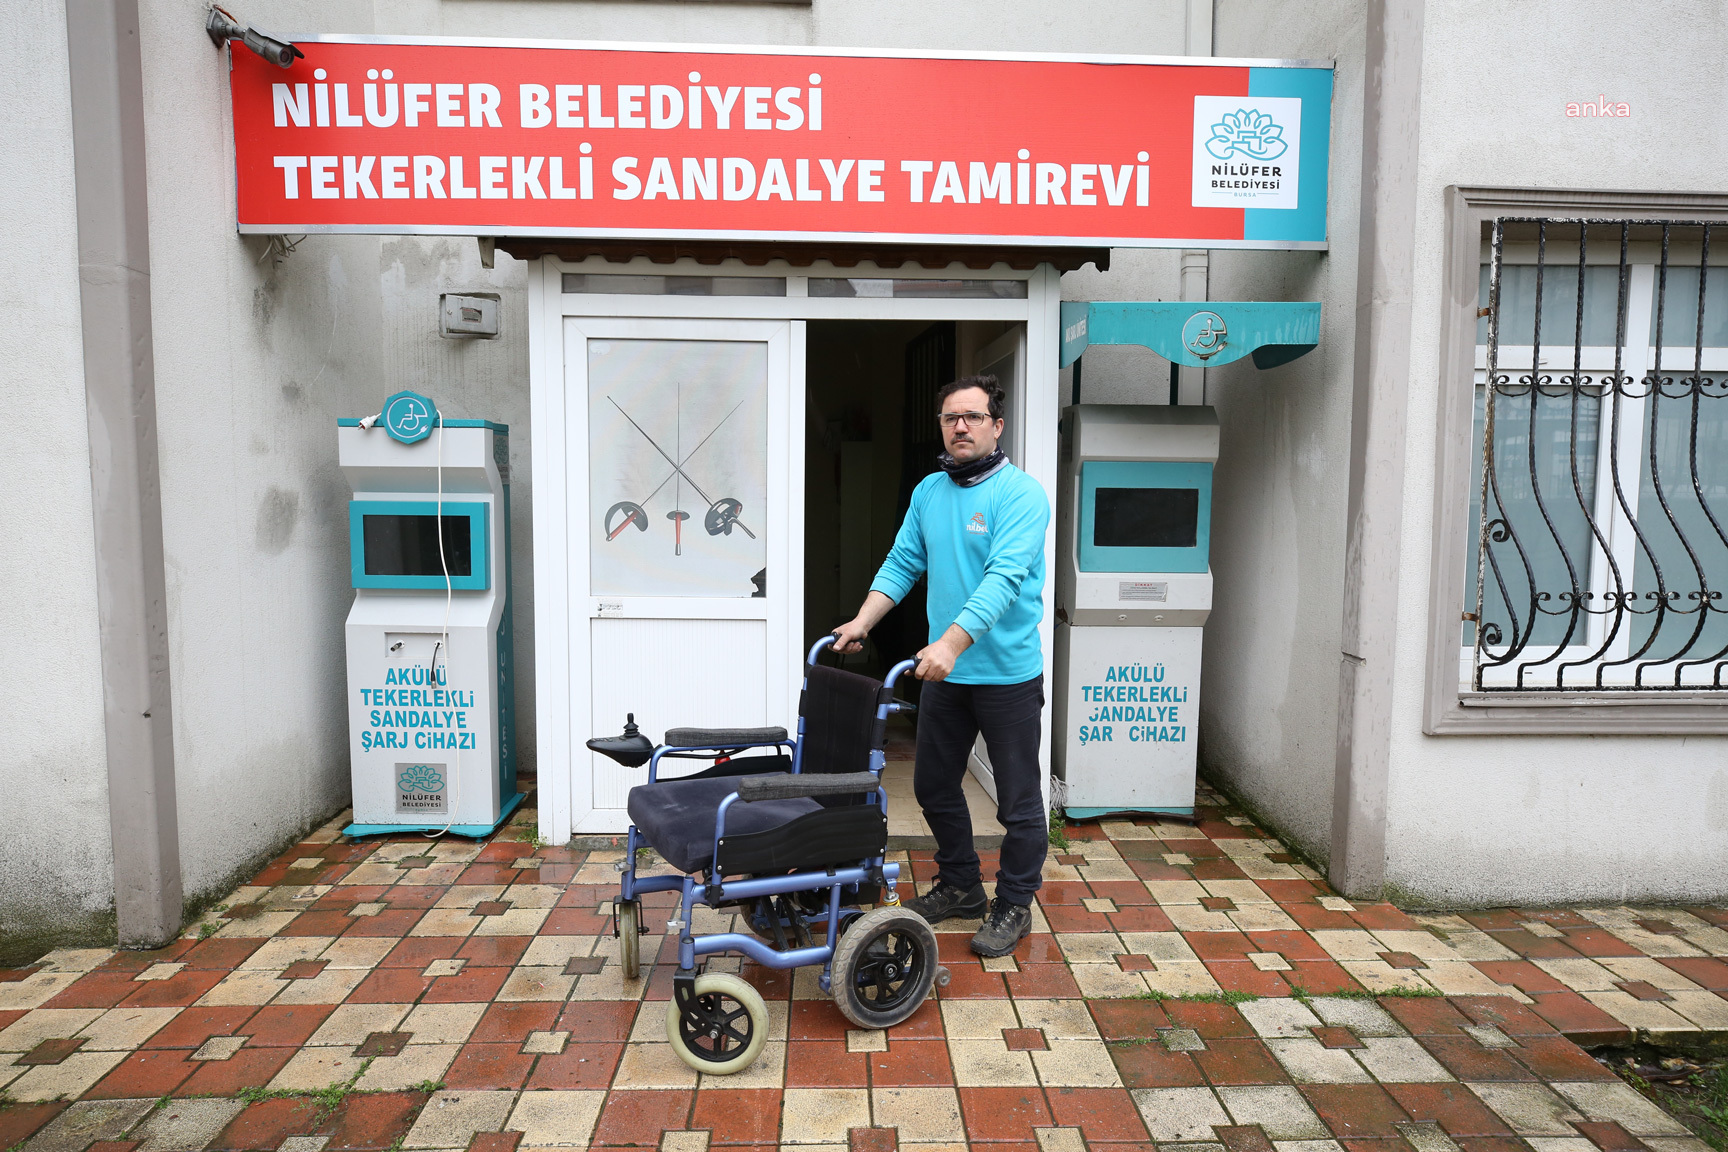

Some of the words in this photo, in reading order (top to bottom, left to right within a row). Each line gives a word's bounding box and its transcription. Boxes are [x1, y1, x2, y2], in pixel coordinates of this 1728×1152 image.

[272, 68, 503, 128] NİLÜFER
[519, 71, 822, 131] BELEDİYESİ
[273, 142, 594, 200] TEKERLEKLİ
[612, 157, 886, 203] SANDALYE
[901, 149, 1150, 207] TAMİREVİ
[1211, 162, 1282, 177] NİLÜFER
[1211, 178, 1280, 190] BELEDİYESİ
[385, 664, 447, 686] AKÜLÜ
[1105, 663, 1165, 682] AKÜLÜ
[360, 688, 475, 708] TEKERLEKLİ
[1081, 686, 1188, 703] TEKERLEKLİ
[370, 709, 467, 728] SANDALYE
[361, 731, 408, 752] ŞARJ
[414, 732, 476, 749] CİHAZI
[1129, 726, 1186, 742] CİHAZI
[402, 793, 442, 801] NİLÜFER
